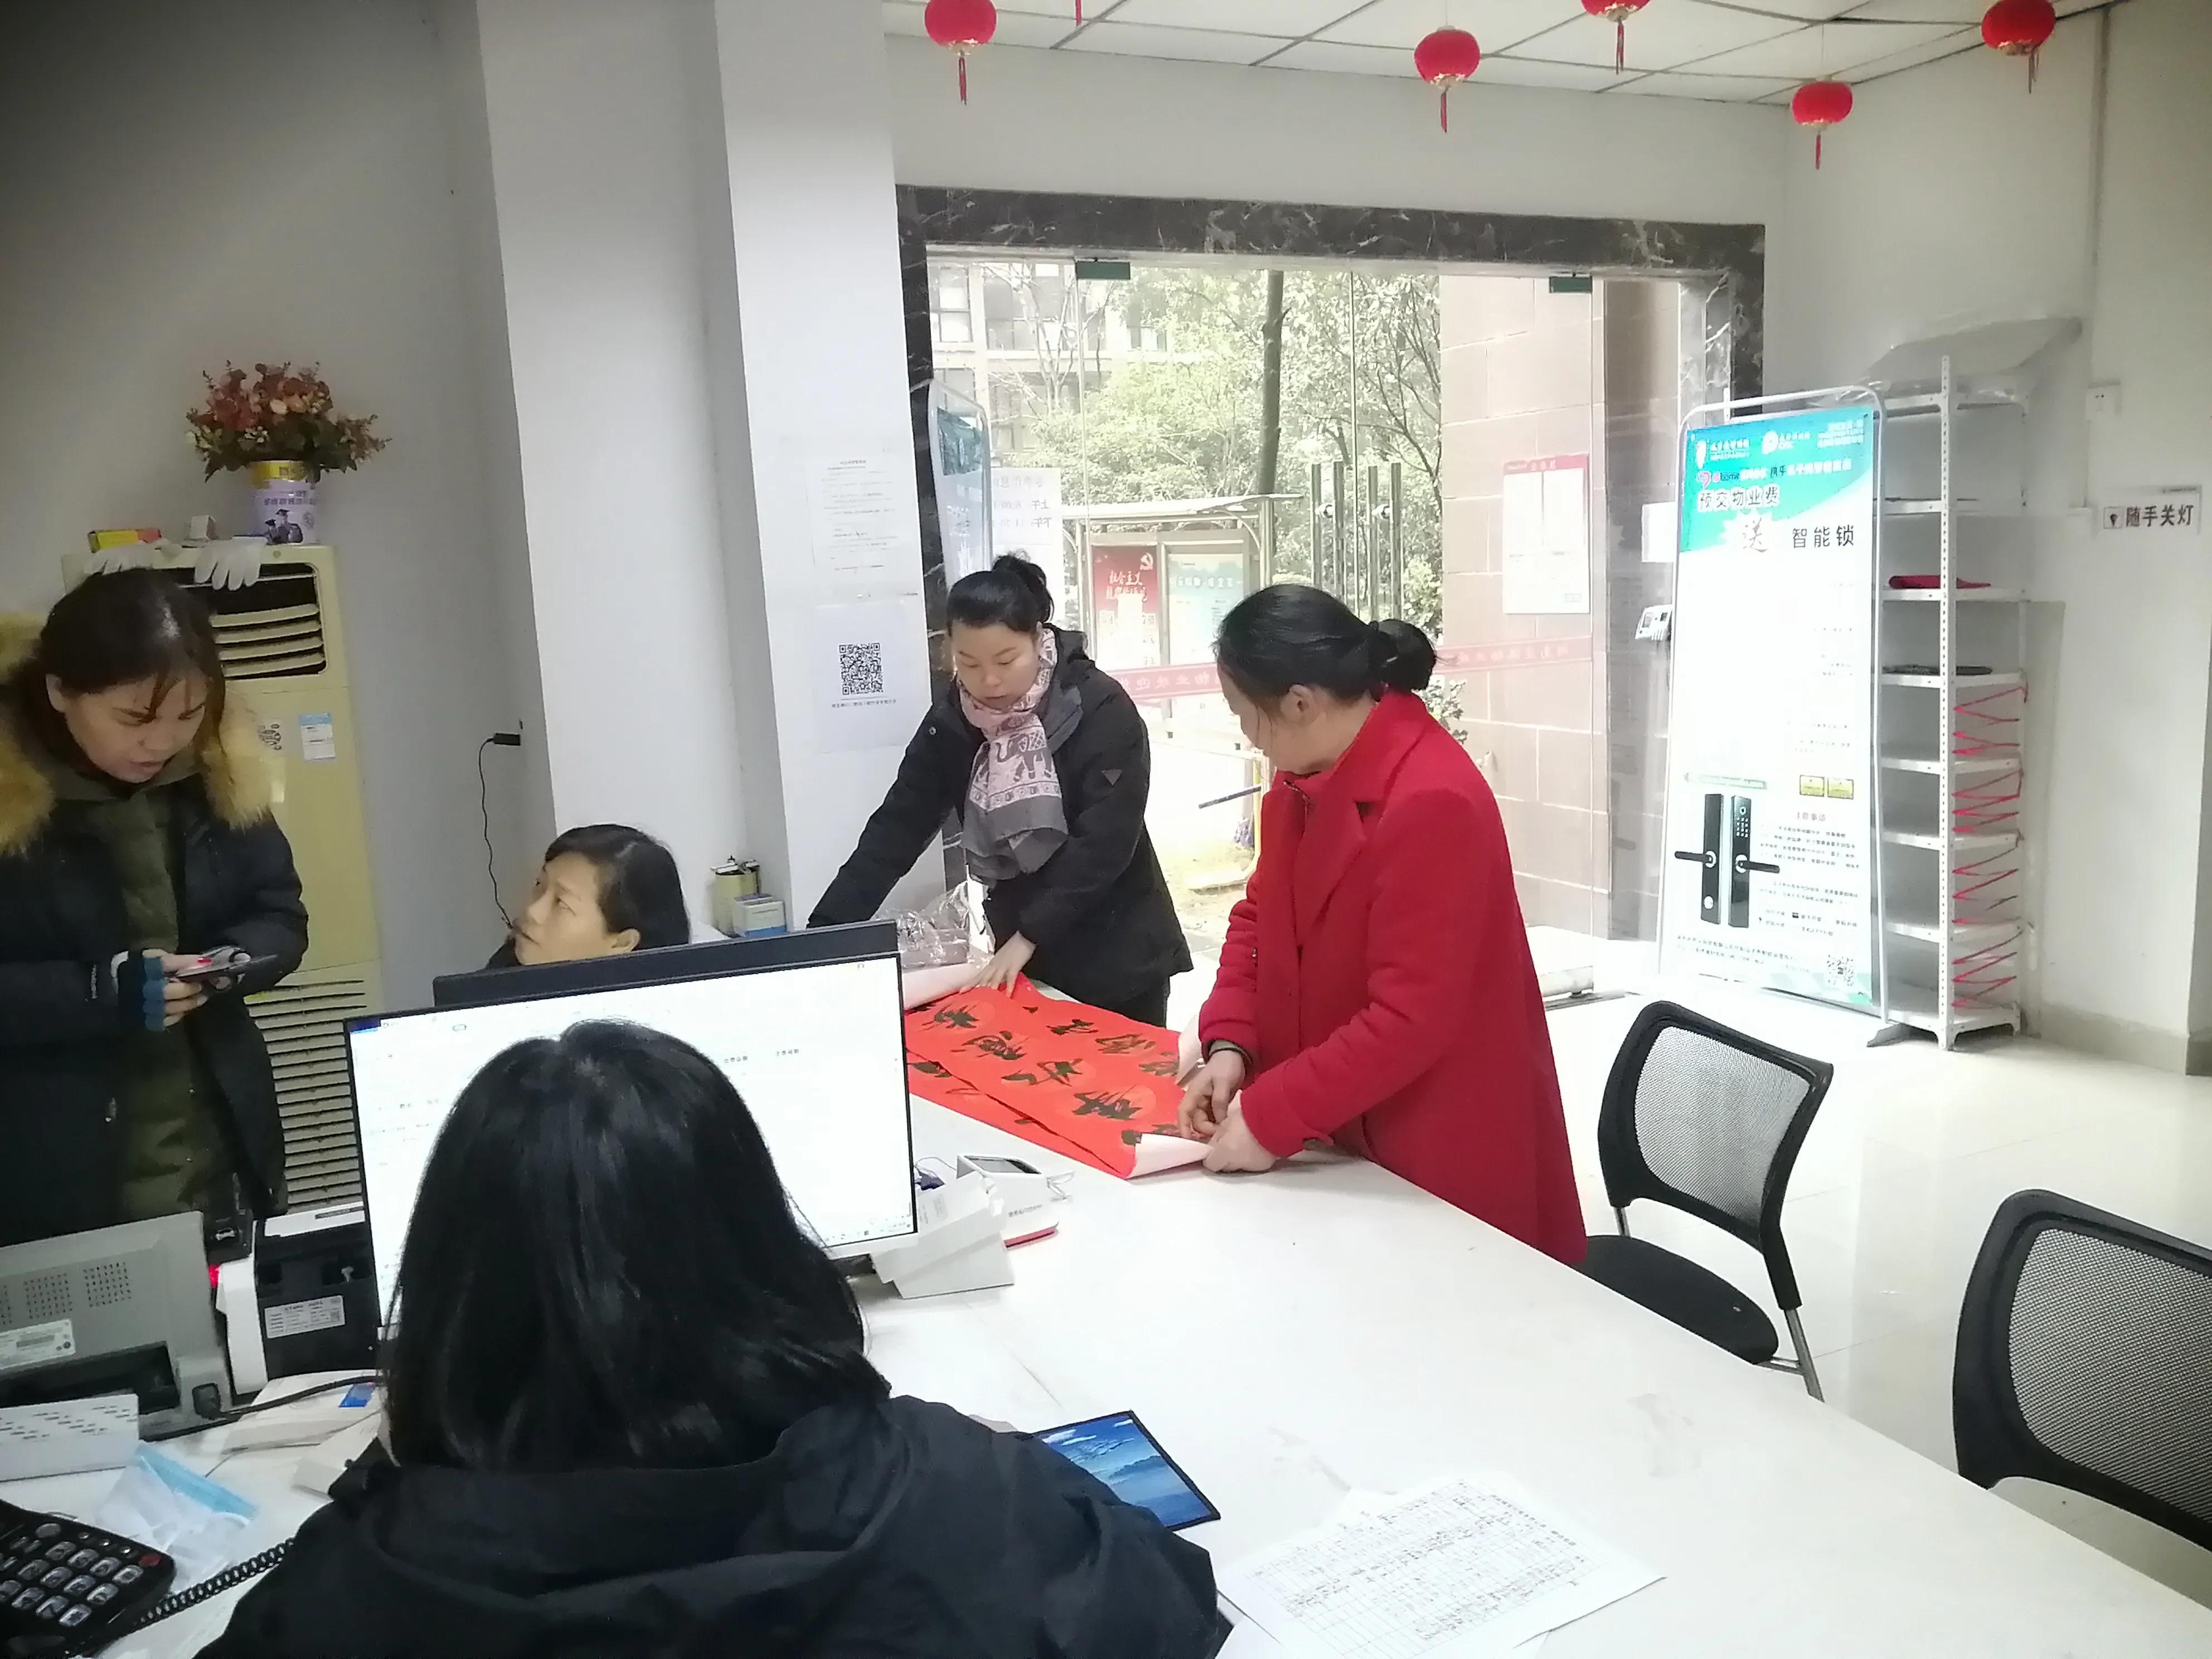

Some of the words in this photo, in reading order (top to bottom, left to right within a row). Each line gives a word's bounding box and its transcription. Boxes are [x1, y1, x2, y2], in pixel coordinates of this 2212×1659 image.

[1700, 486, 1778, 510] 预交物业费
[2126, 504, 2194, 527] 随手关灯
[1743, 517, 1768, 552] 送
[1792, 523, 1855, 549] 智能锁
